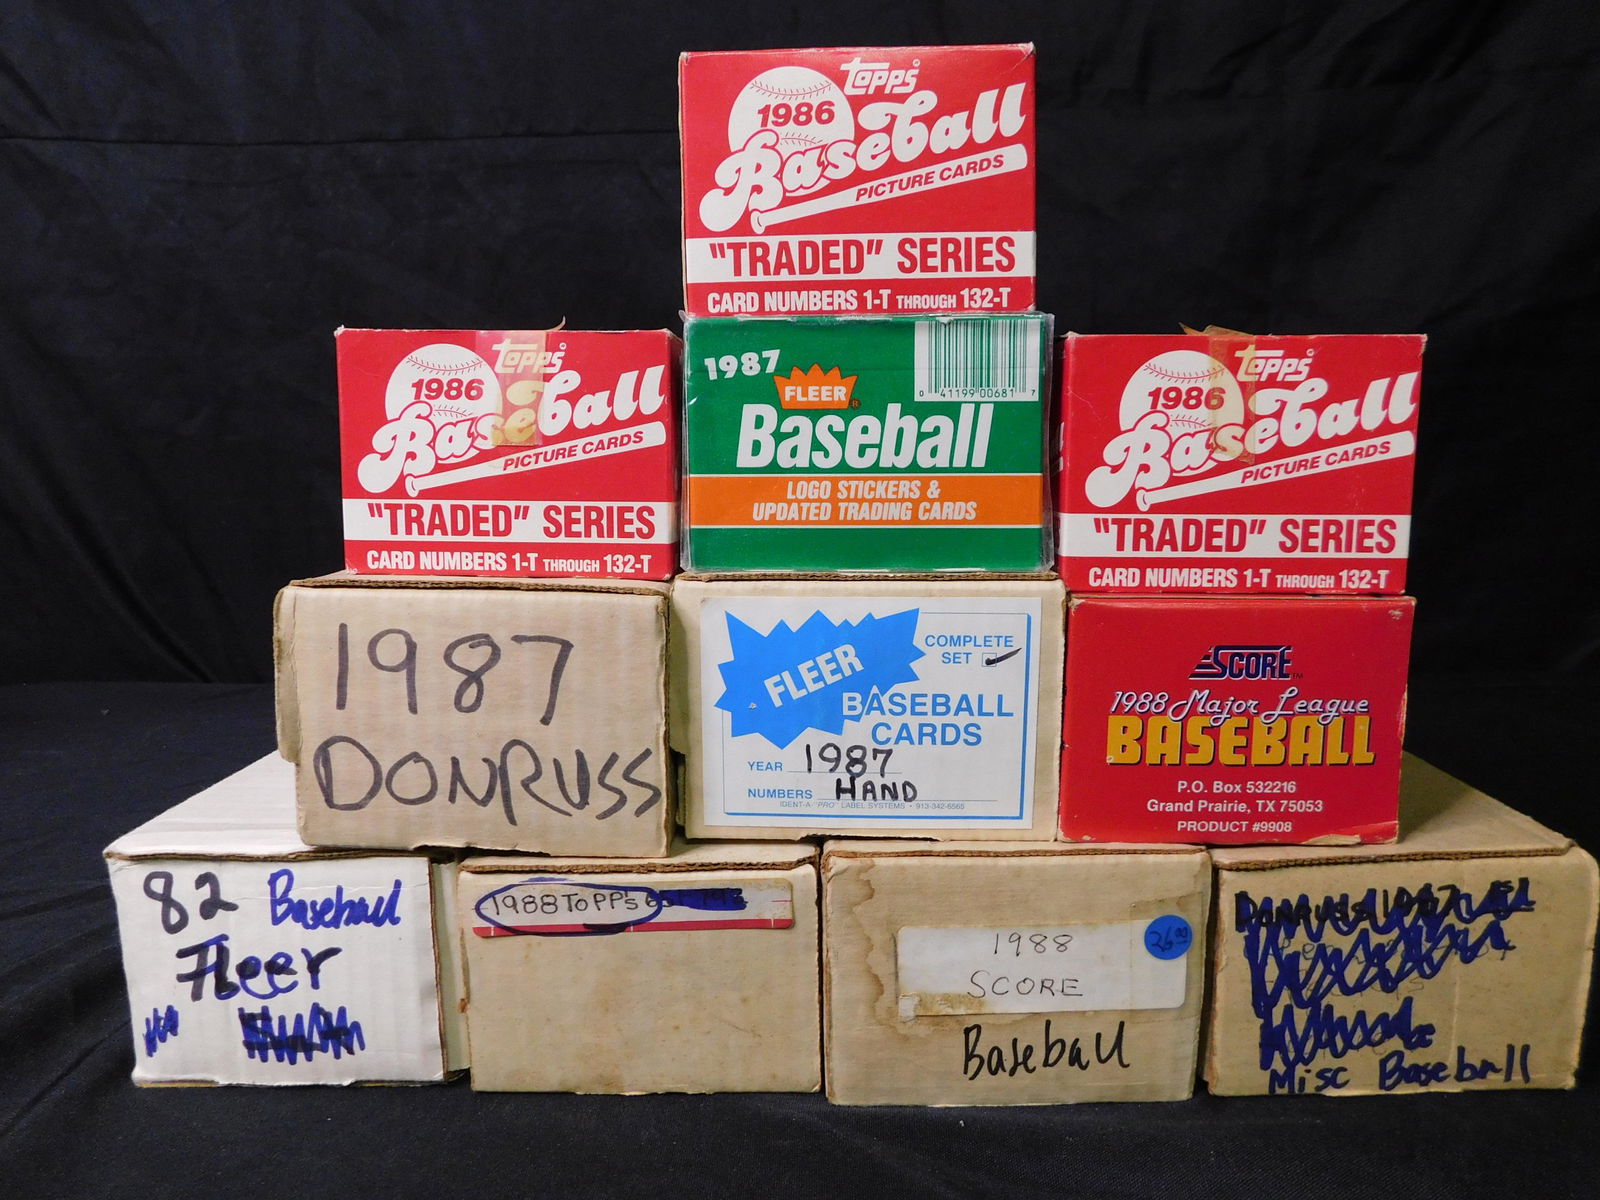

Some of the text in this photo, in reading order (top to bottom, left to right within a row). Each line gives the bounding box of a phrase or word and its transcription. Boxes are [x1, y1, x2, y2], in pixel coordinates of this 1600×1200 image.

[757, 100, 836, 127] 1986
[699, 82, 1027, 232] Baseball
[854, 154, 1005, 202] PICTURE CARDS
[709, 236, 1016, 278] "TRADED" SERIES
[707, 287, 1011, 313] CARD NUMBERS 1-T THROUGH 132-T
[704, 349, 781, 381] 1987
[411, 378, 485, 401] 1986
[784, 385, 847, 401] FLEER
[1148, 386, 1226, 410] 1986
[357, 365, 666, 494] Baseball
[736, 403, 994, 469] Baseball
[1085, 371, 1421, 508] Baseball
[502, 430, 644, 472] PICTURE CARDS
[1240, 441, 1391, 484] PICTURE CARDS
[787, 480, 941, 500] LOGO STICKERS &
[367, 503, 656, 539] "TRADED" SERIES
[752, 501, 977, 521] UPDATED TRADING CARDS
[1093, 517, 1397, 554] "TRADED" SERIES
[366, 550, 652, 574] CARD NUMBERS 1-T THROUGH 132-T
[1088, 567, 1390, 589] CARD NUMBERS 1-T THROUGH 132-T
[925, 634, 1014, 648] COMPLETE
[941, 652, 972, 664] SET
[1189, 645, 1293, 680] SCORE
[336, 622, 575, 726] 1987
[763, 644, 865, 708] FLEER
[842, 692, 1014, 717] BASEBALL
[1110, 686, 1369, 727] 1988 Major League
[871, 722, 983, 746] CARDS
[1106, 715, 1376, 766] BASEBALL
[747, 761, 783, 772] YEAR
[805, 743, 893, 778] 1987
[313, 735, 662, 826] DONRUSS
[747, 788, 813, 799] NUMBERS
[836, 777, 917, 802] HAND
[1177, 781, 1297, 793] P.O. Box 532216
[1147, 800, 1323, 814] Grand Prairie, TX 75053
[1177, 821, 1292, 832] PRODUCT #9908
[143, 871, 239, 934] 82
[492, 893, 558, 916] 1988
[993, 932, 1074, 956] 1988
[176, 933, 342, 1001] Fleer
[966, 969, 1083, 999] SCORE
[962, 1020, 1131, 1081] Baseball
[1268, 1044, 1531, 1095] Misc Baseball
